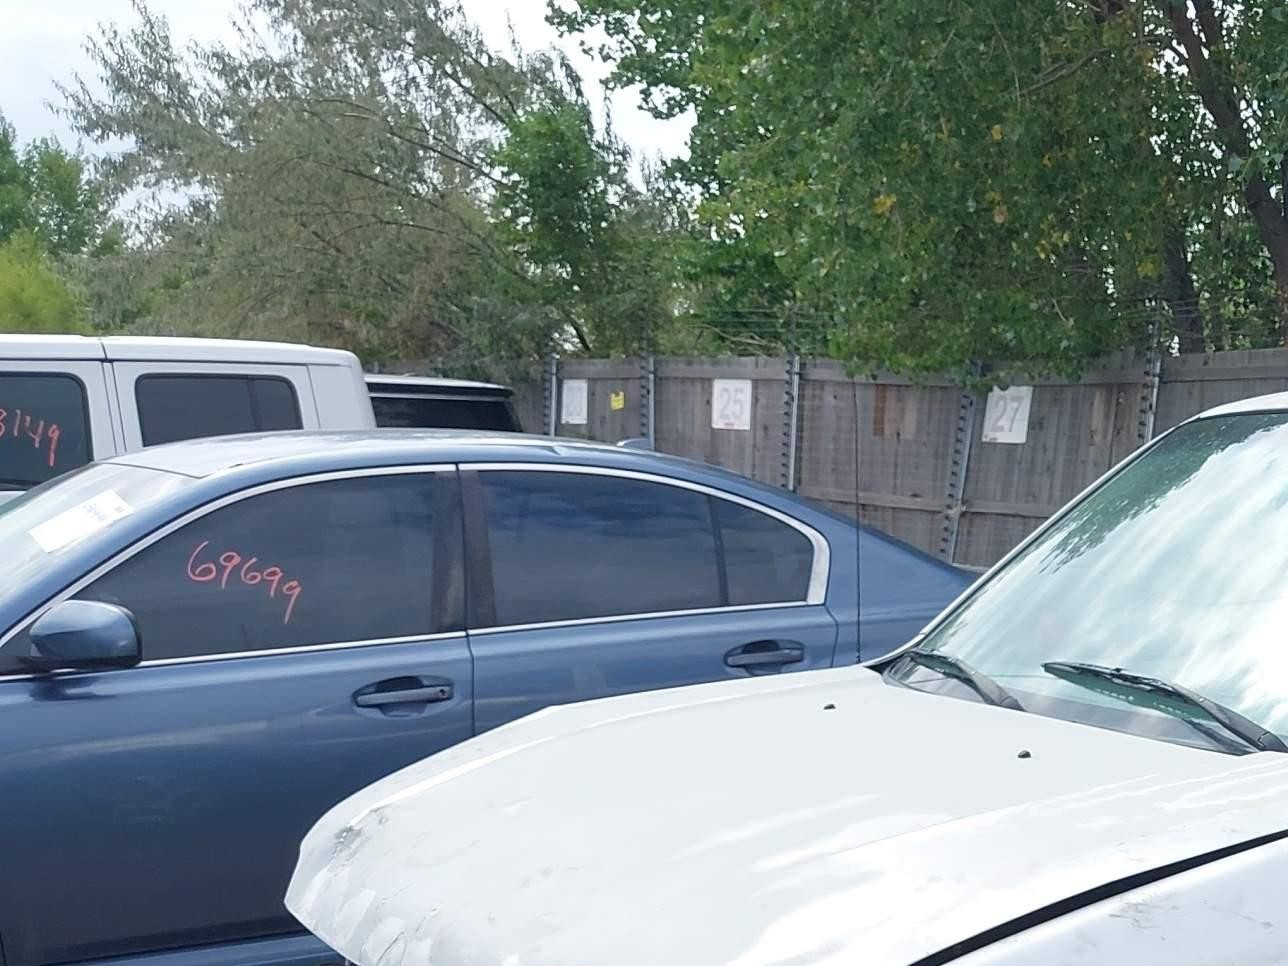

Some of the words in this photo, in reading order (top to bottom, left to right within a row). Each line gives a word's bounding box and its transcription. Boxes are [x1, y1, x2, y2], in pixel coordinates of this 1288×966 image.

[719, 386, 746, 421] 25
[990, 395, 1025, 433] 27
[187, 540, 302, 625] 69699
